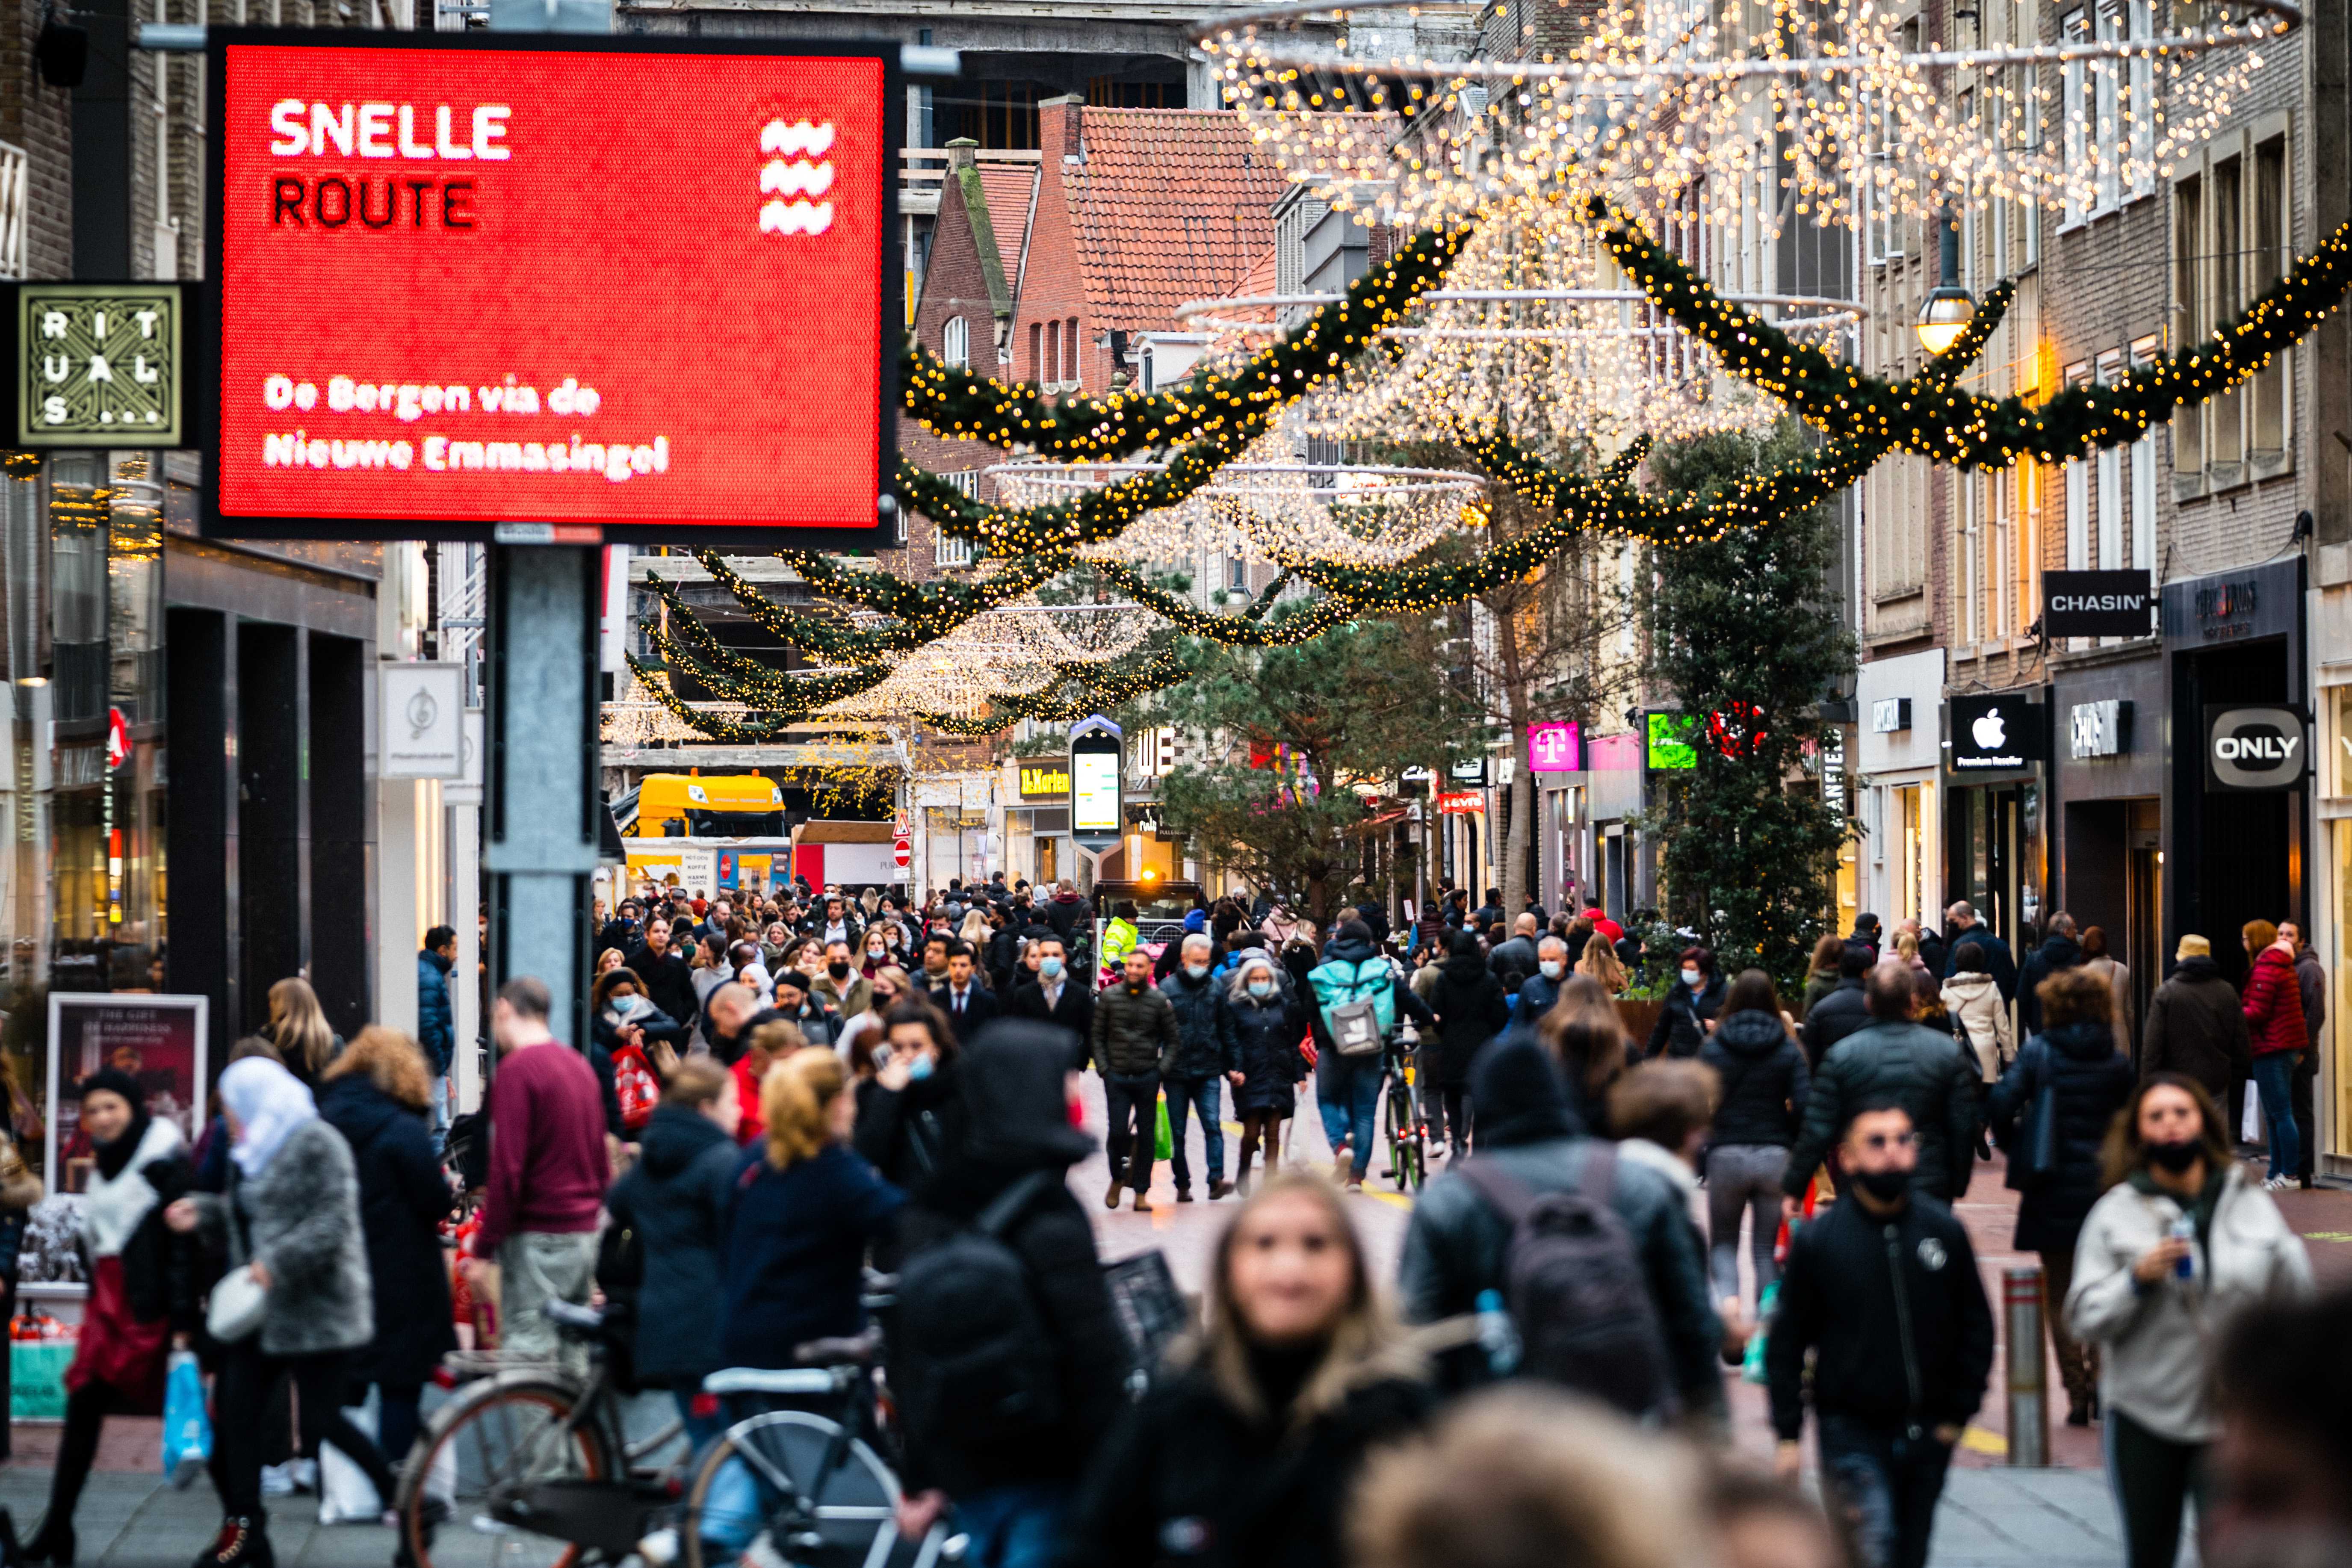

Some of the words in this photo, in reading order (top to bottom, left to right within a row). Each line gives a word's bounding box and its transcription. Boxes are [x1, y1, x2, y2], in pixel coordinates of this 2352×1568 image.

[271, 98, 511, 160] SNELLE
[275, 177, 473, 228] ROUTE
[263, 373, 318, 411] De
[328, 375, 470, 421] Bergen
[478, 372, 541, 413] via
[548, 375, 601, 416] de
[263, 429, 413, 470] Nieuwe
[423, 430, 670, 481] Emmasingel
[2051, 595, 2145, 611] CHASIN'
[1957, 757, 1992, 766] Premium
[1992, 756, 2023, 766] Reseller
[2215, 736, 2299, 759] ONLY
